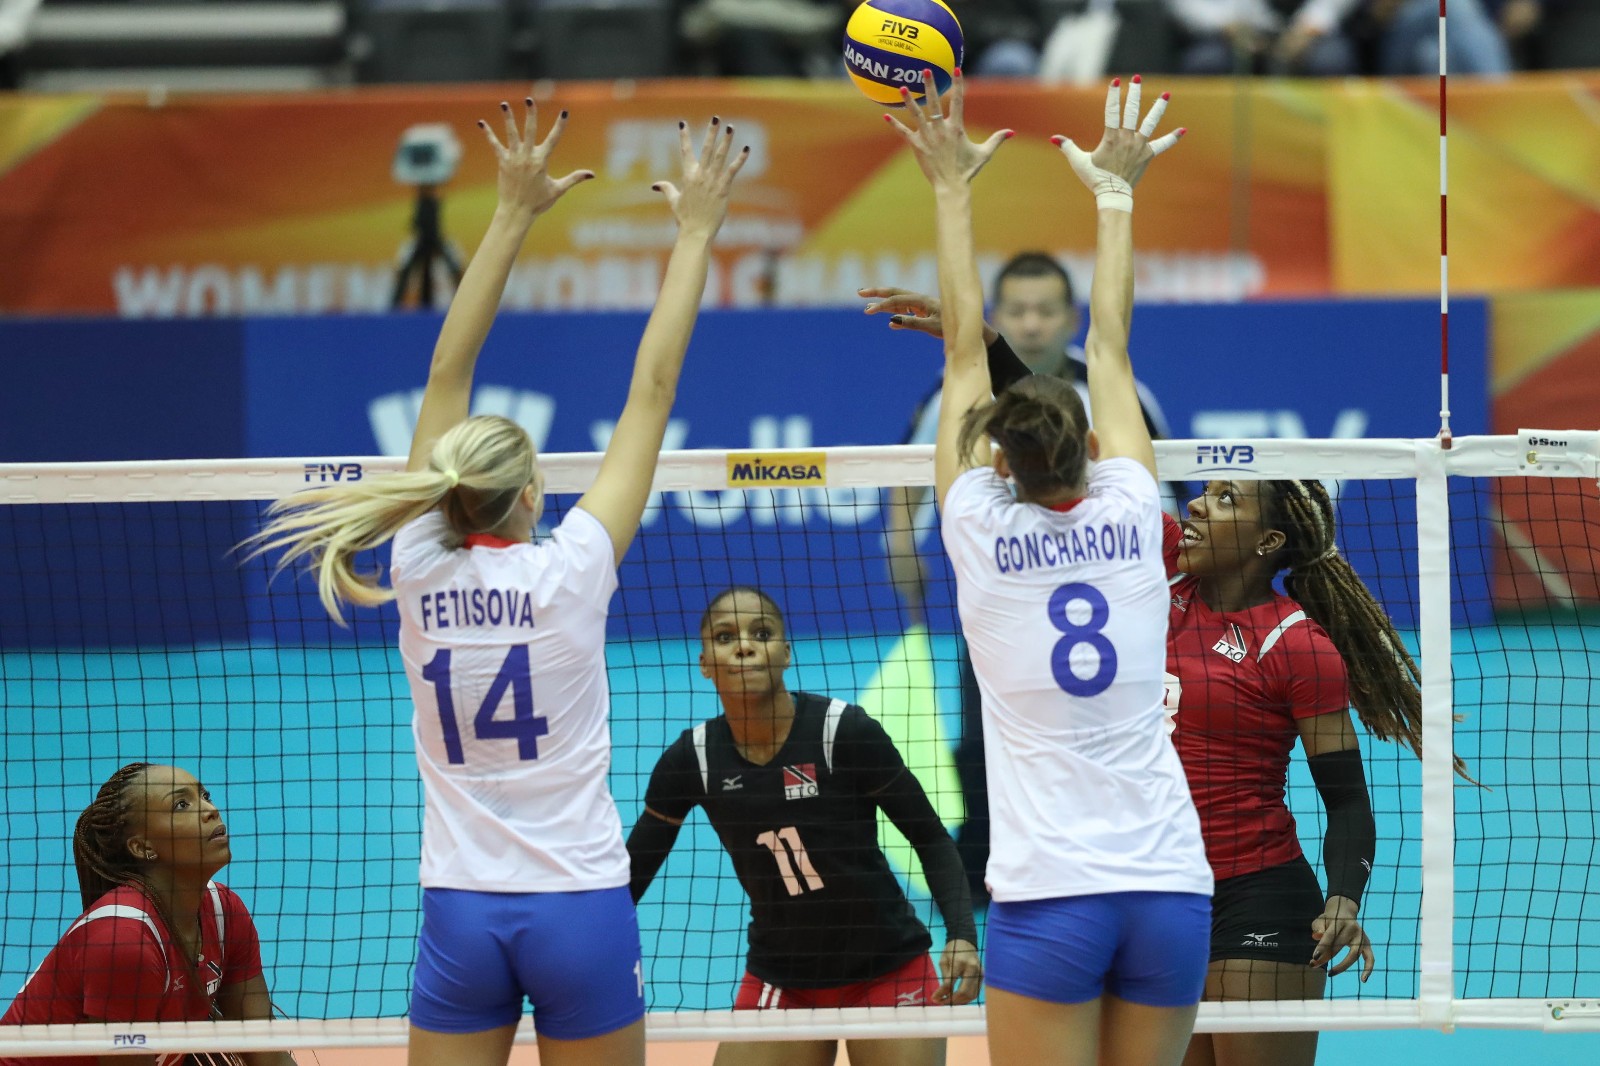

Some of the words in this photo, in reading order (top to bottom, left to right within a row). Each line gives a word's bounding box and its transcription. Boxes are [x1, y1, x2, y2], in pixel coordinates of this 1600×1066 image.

[881, 20, 919, 39] FIVB
[845, 43, 889, 80] JAPAN
[1197, 445, 1255, 464] FIVB
[304, 463, 363, 482] FIVB
[995, 523, 1142, 574] GONCHAROVA
[421, 588, 535, 632] FETISOVA
[1047, 582, 1118, 698] 8
[1215, 641, 1245, 661] TTO
[422, 643, 549, 765] 14
[786, 785, 818, 799] TTO
[756, 826, 825, 896] 11
[114, 1034, 147, 1045] FIVB
